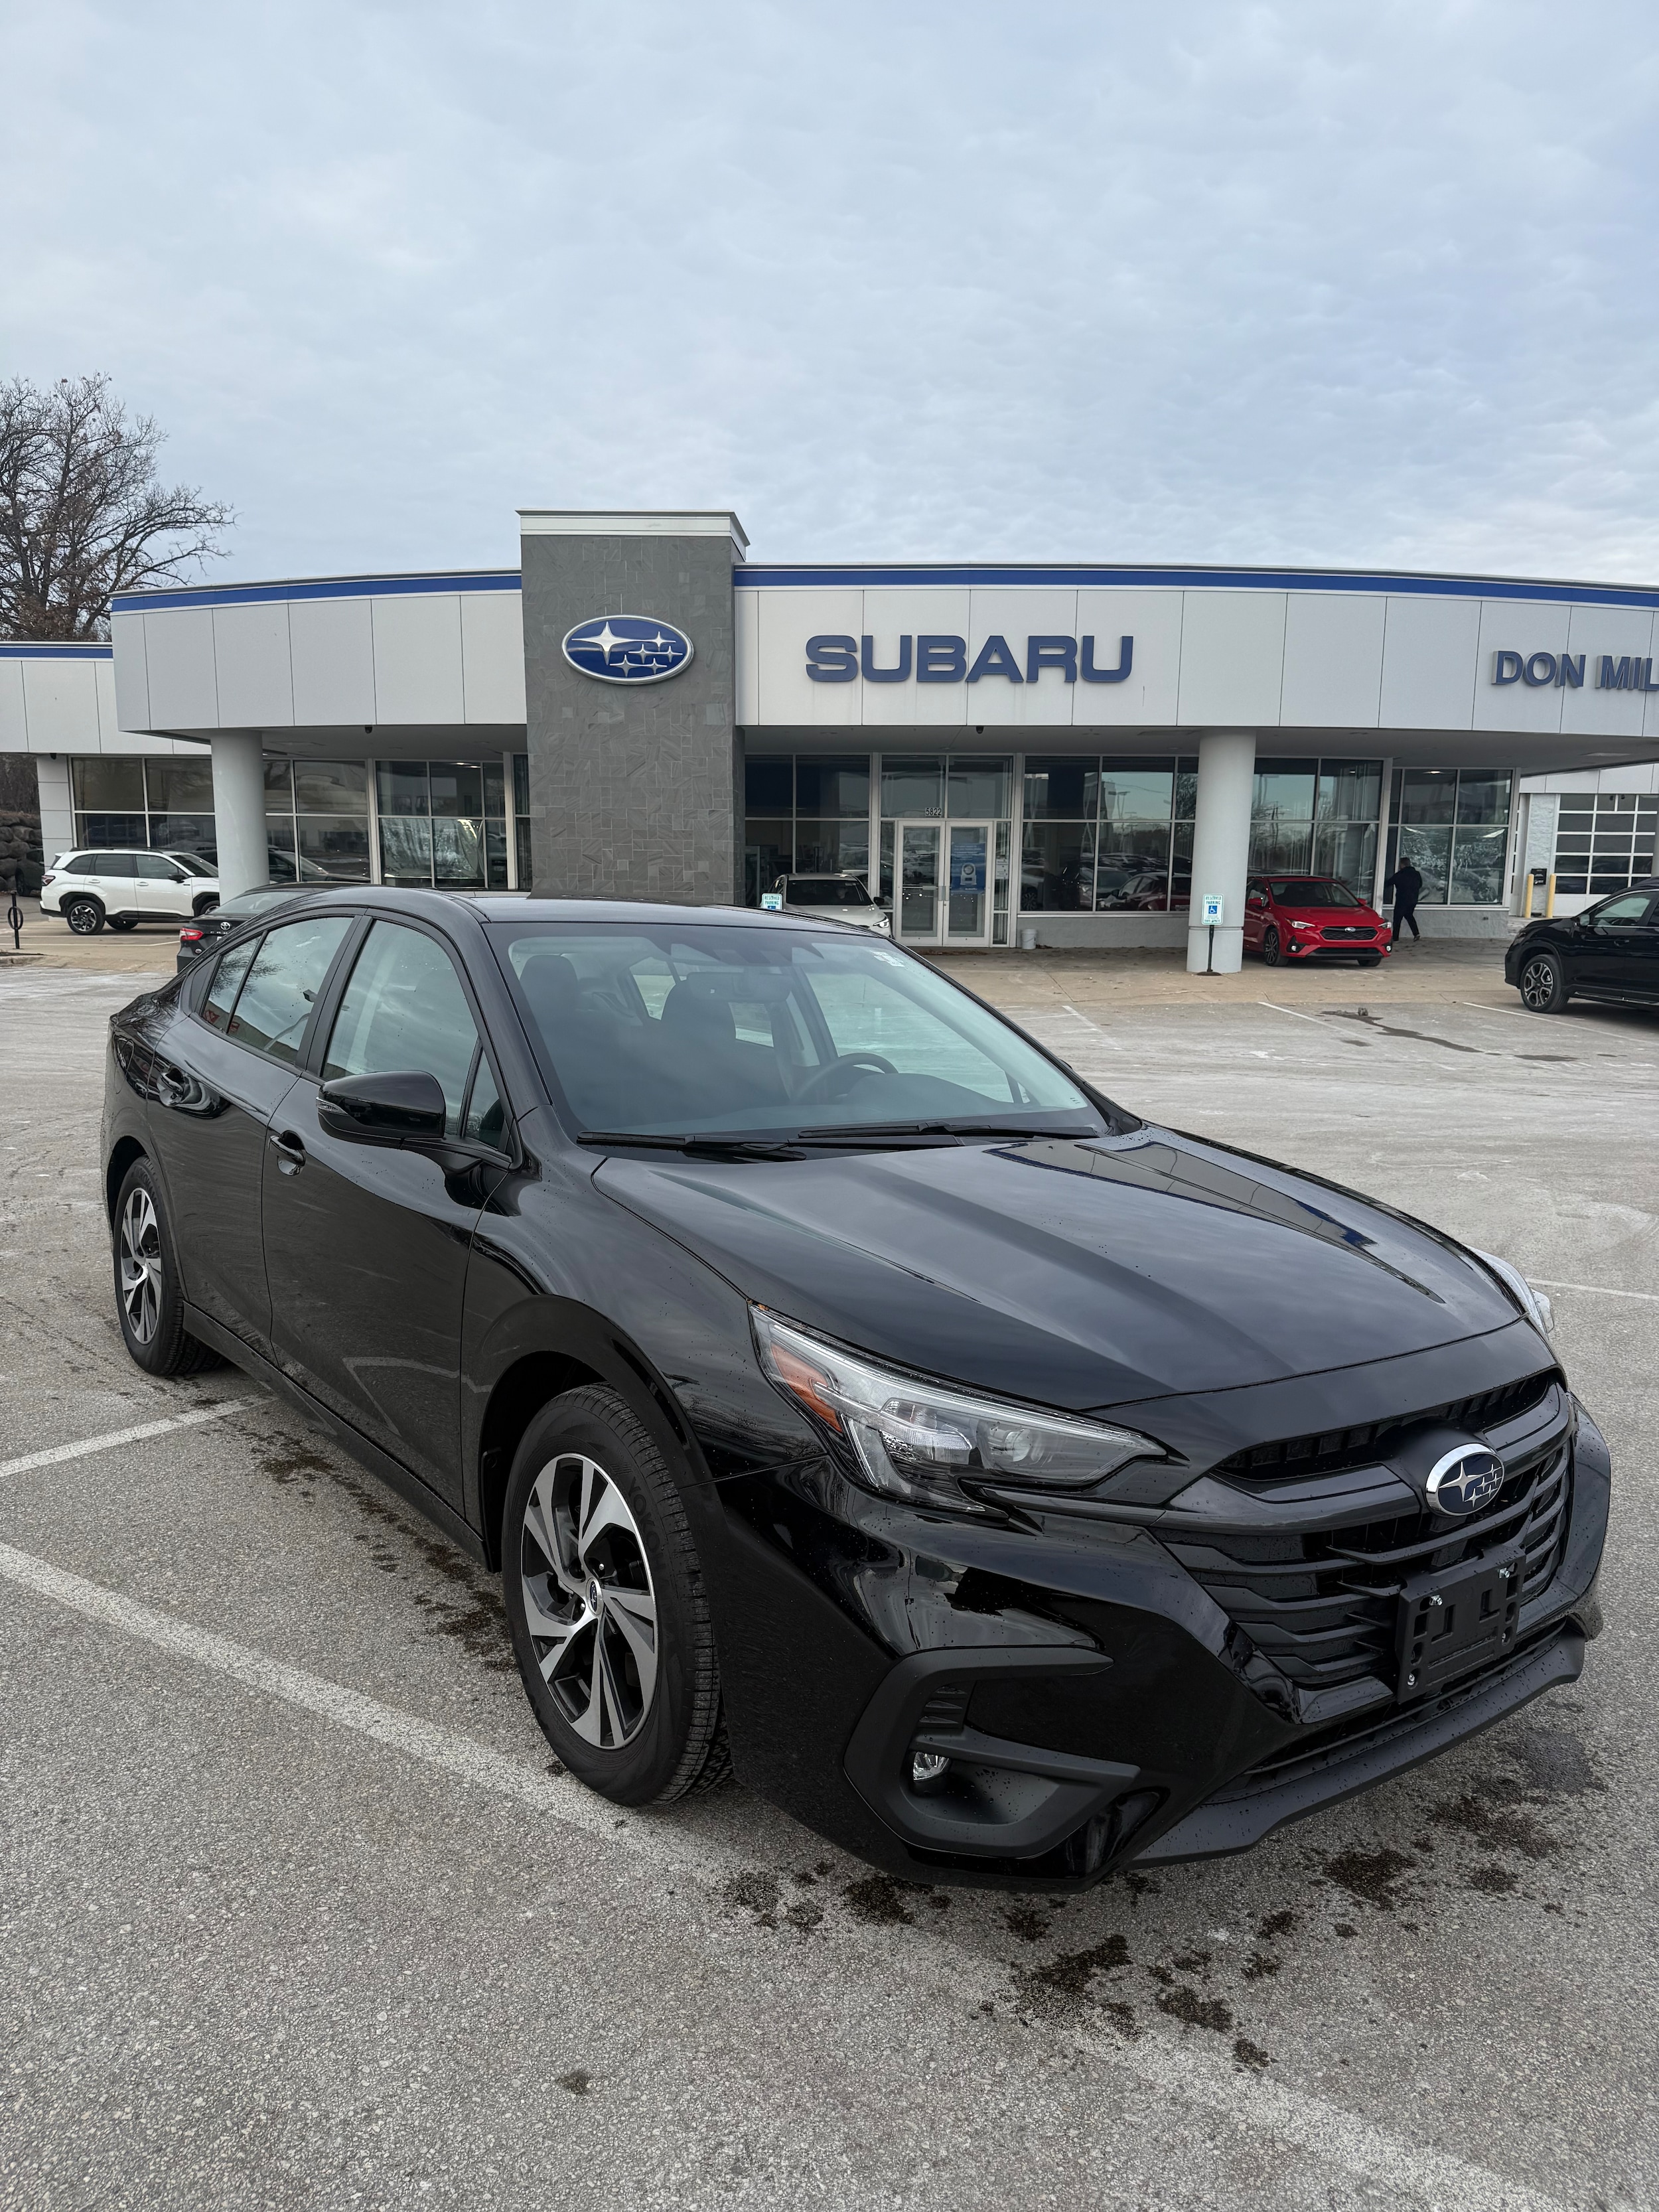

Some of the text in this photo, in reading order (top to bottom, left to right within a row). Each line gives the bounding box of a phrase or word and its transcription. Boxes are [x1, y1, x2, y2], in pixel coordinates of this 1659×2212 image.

[806, 635, 1133, 683] SUBARU
[1492, 650, 1659, 691] DON MIL
[925, 807, 942, 816] 5822
